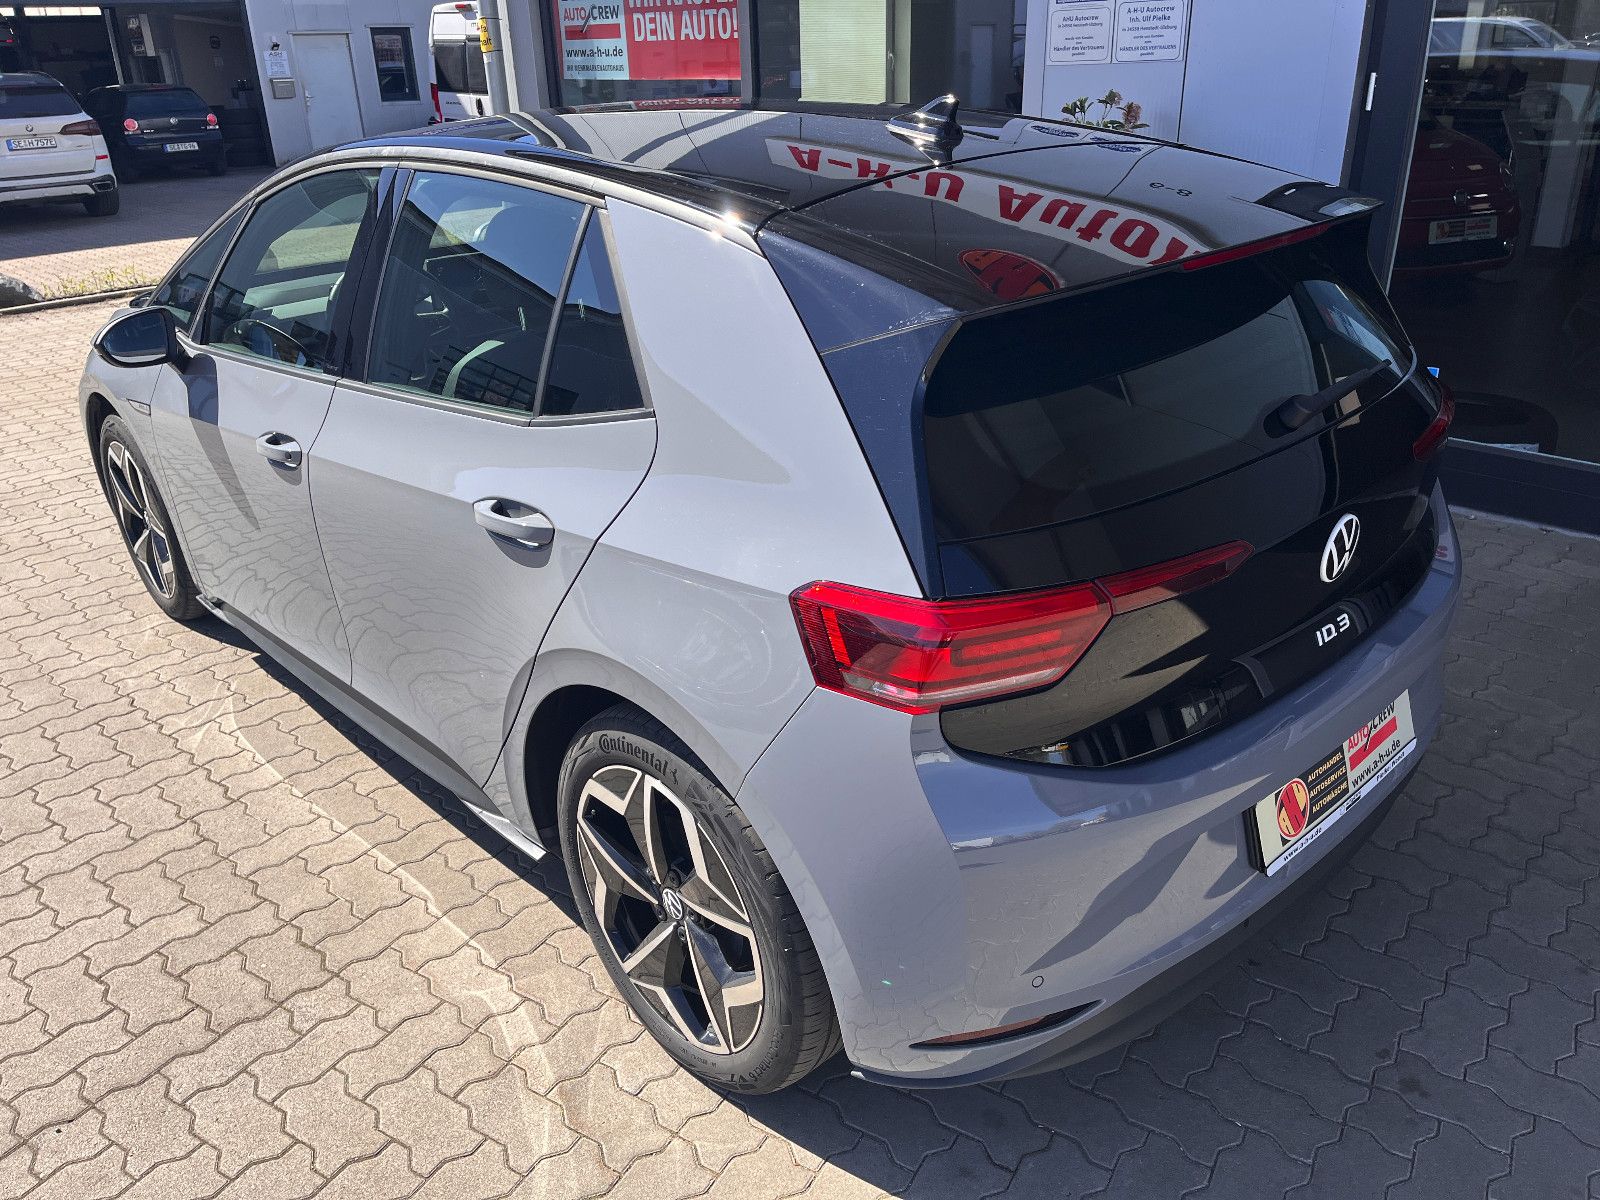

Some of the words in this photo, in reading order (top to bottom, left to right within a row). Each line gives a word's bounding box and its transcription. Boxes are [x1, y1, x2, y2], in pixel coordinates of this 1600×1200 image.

[633, 11, 675, 42] DEIN
[680, 7, 739, 41] AUTO!
[1146, 5, 1175, 13] Autocrew
[1152, 14, 1171, 22] Pielke
[565, 47, 624, 58] www.a-h-u.de
[12, 140, 24, 148] SE
[1347, 724, 1370, 753] AUTO
[599, 733, 669, 777] Continental
[1307, 752, 1344, 783] AUTOHANDEL
[1352, 738, 1401, 789] www.a-h-u.de
[1309, 766, 1347, 799] AUTOSERVICE
[1312, 780, 1349, 814] AUTOWÄSCHE
